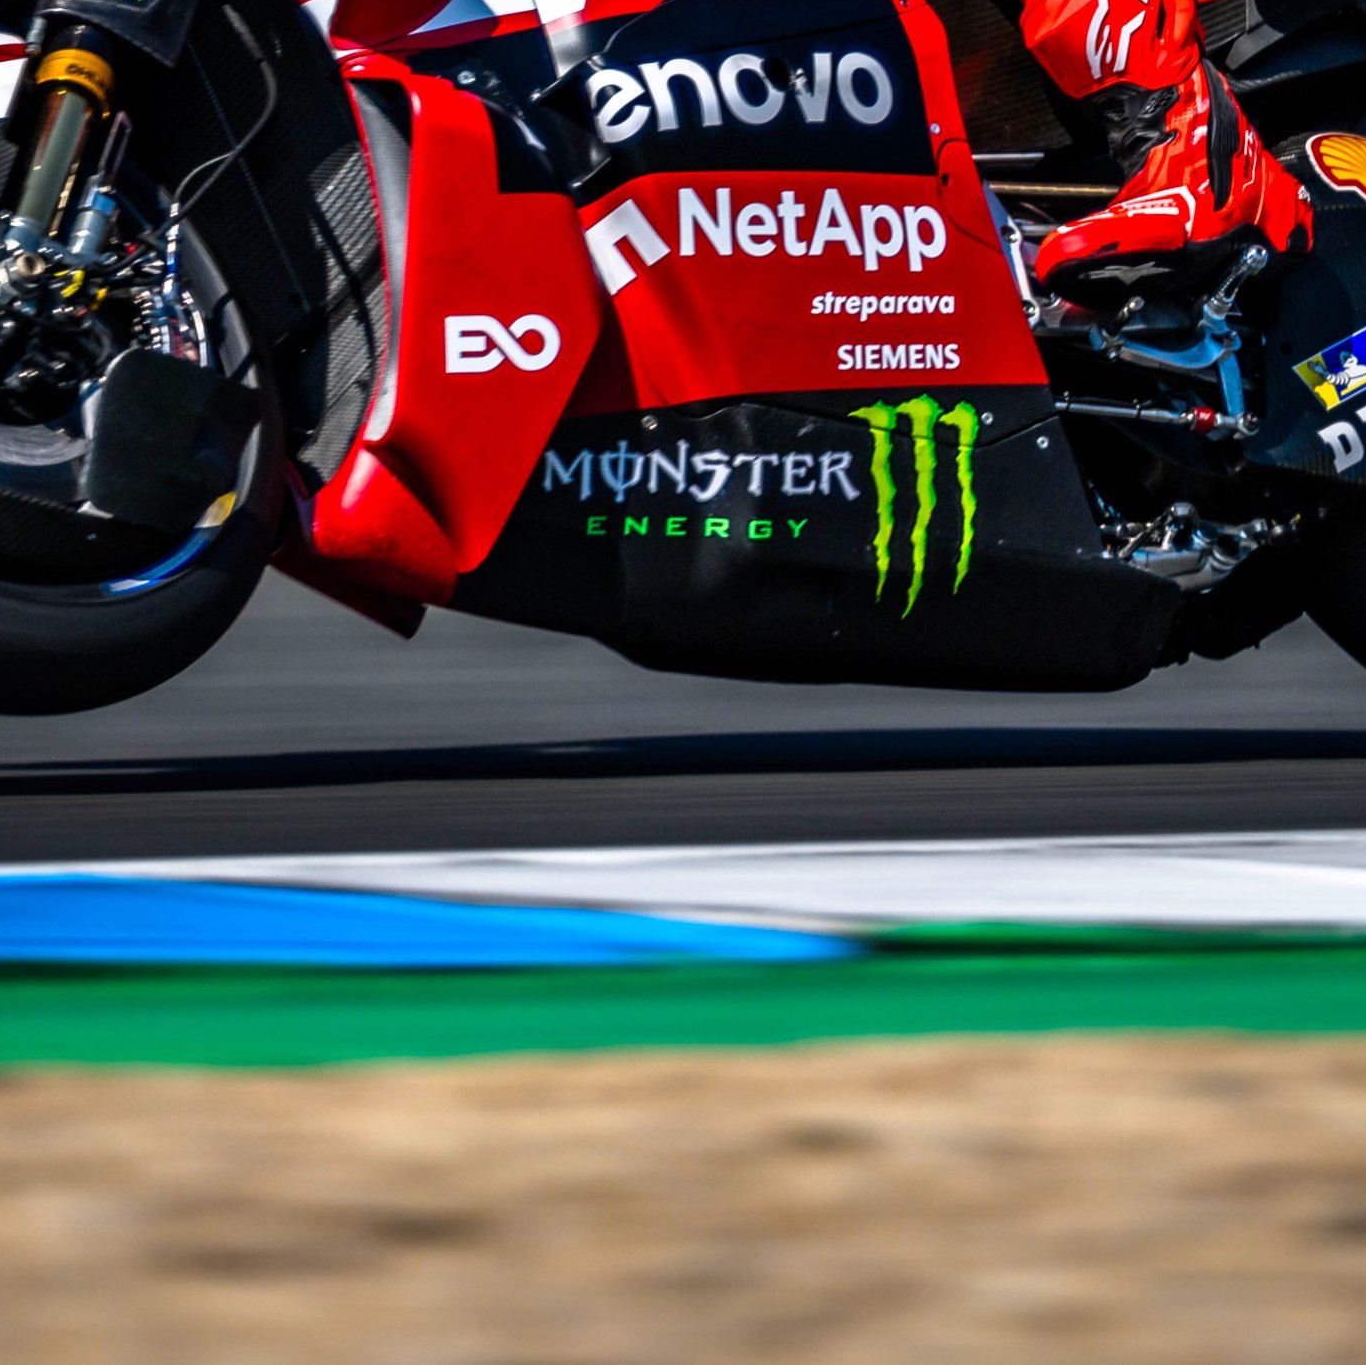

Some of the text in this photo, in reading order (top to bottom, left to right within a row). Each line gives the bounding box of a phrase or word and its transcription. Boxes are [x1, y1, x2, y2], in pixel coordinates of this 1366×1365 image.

[587, 51, 893, 143] enovo
[678, 187, 947, 272] NetApp
[811, 291, 955, 322] streparava
[837, 343, 960, 370] SIEMENS
[544, 439, 860, 503] MONSTER
[586, 515, 808, 539] ENERGY
